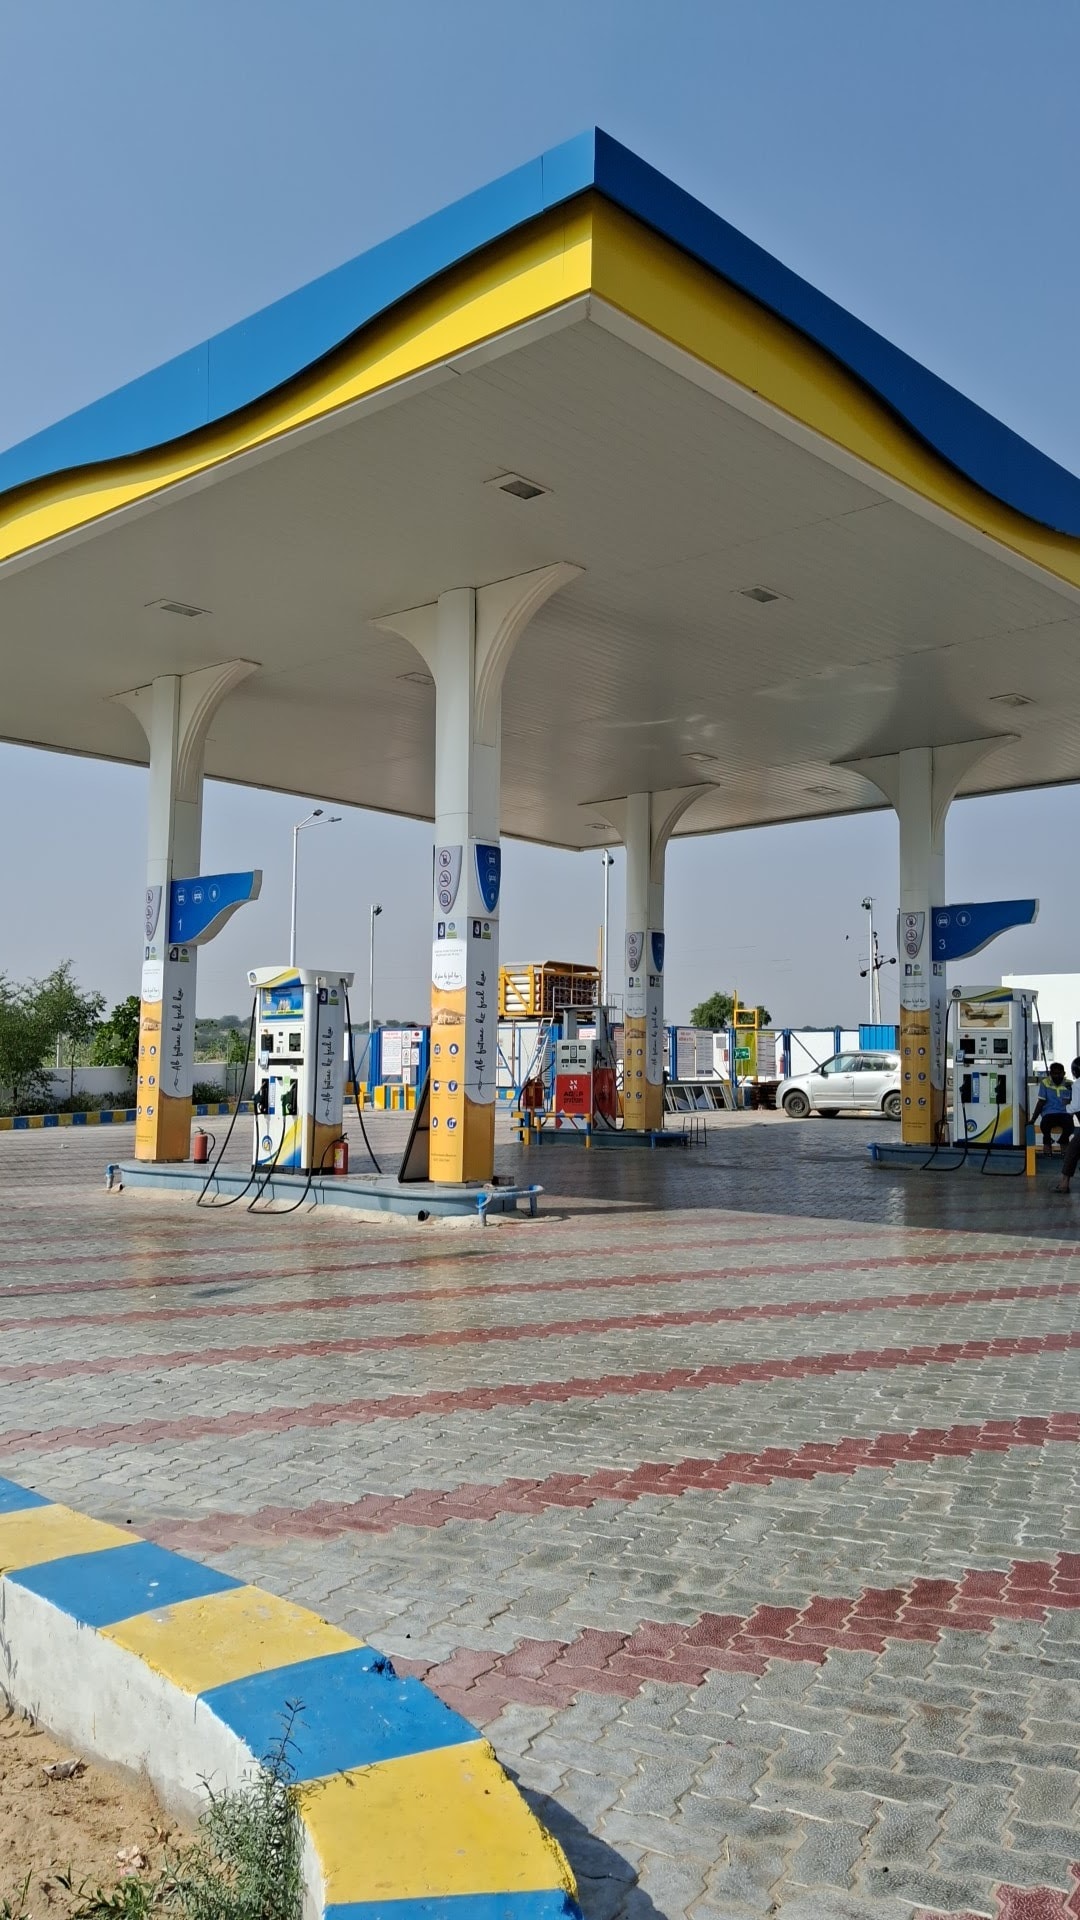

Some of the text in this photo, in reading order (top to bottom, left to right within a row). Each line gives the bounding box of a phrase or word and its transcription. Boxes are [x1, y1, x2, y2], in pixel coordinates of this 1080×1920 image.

[178, 919, 182, 931] 1
[939, 939, 946, 949] 3
[476, 990, 488, 1009] feel
[172, 1004, 184, 1019] feel
[475, 1012, 485, 1023] ko
[172, 1022, 182, 1032] ko
[173, 1035, 184, 1057] future
[476, 1028, 488, 1054] future
[323, 1041, 335, 1055] feel
[171, 1060, 181, 1071] Ab
[475, 1059, 485, 1072] Ab
[323, 1069, 334, 1089] future
[321, 1092, 333, 1102] Ab
